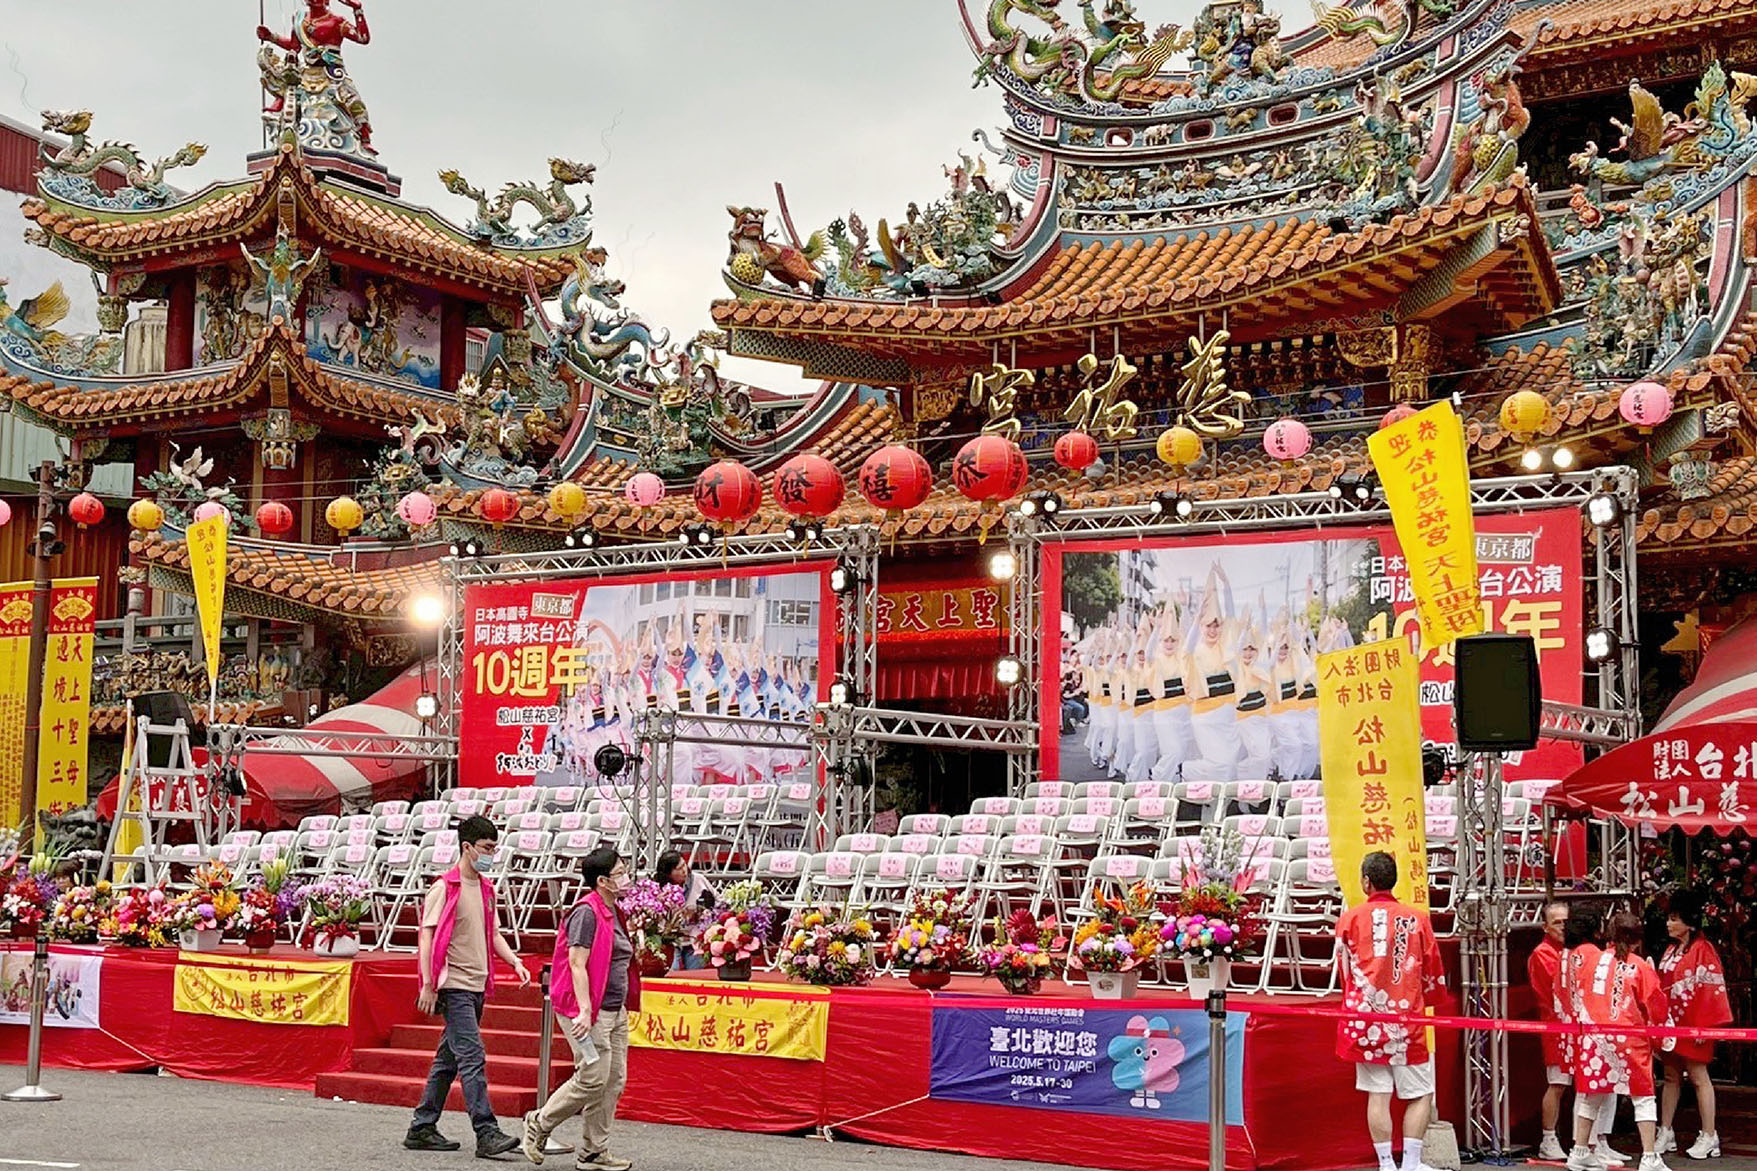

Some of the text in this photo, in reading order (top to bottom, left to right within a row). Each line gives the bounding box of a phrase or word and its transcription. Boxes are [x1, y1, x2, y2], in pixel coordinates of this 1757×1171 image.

[535, 597, 573, 616] 東京都
[474, 620, 590, 646] 阿波舞來台公演
[473, 645, 588, 697] 10週年
[646, 1013, 775, 1052] 松山慈祐宮
[989, 1026, 1098, 1057] 臺北歡迎您
[989, 1055, 1097, 1073] WELCOME TO TAIPEI
[1010, 1074, 1073, 1089] 2025.5.17-30
